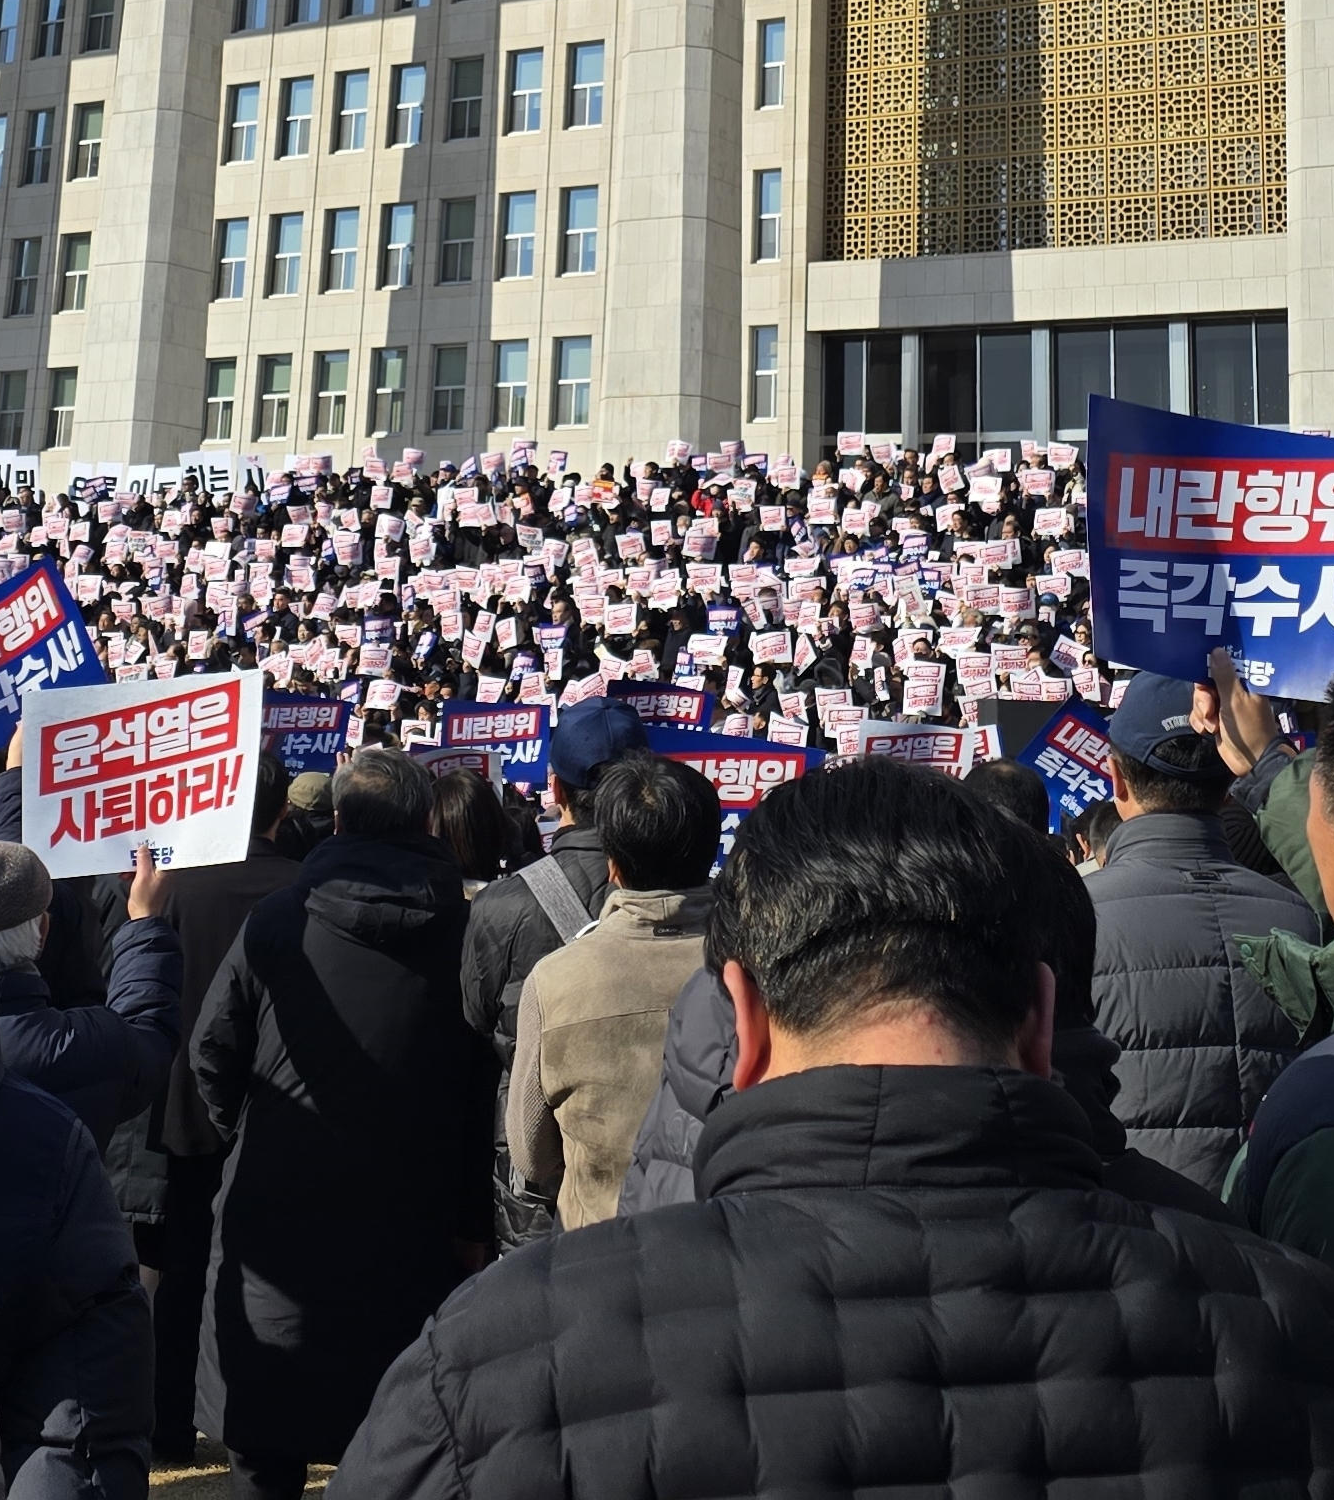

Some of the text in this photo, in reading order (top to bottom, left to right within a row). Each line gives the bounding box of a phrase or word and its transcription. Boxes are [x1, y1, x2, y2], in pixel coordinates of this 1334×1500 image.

[51, 691, 230, 784] 윤석열은
[261, 706, 339, 729] 내란행위
[451, 711, 537, 741] 내란행위
[49, 754, 244, 848] 사퇴하라!
